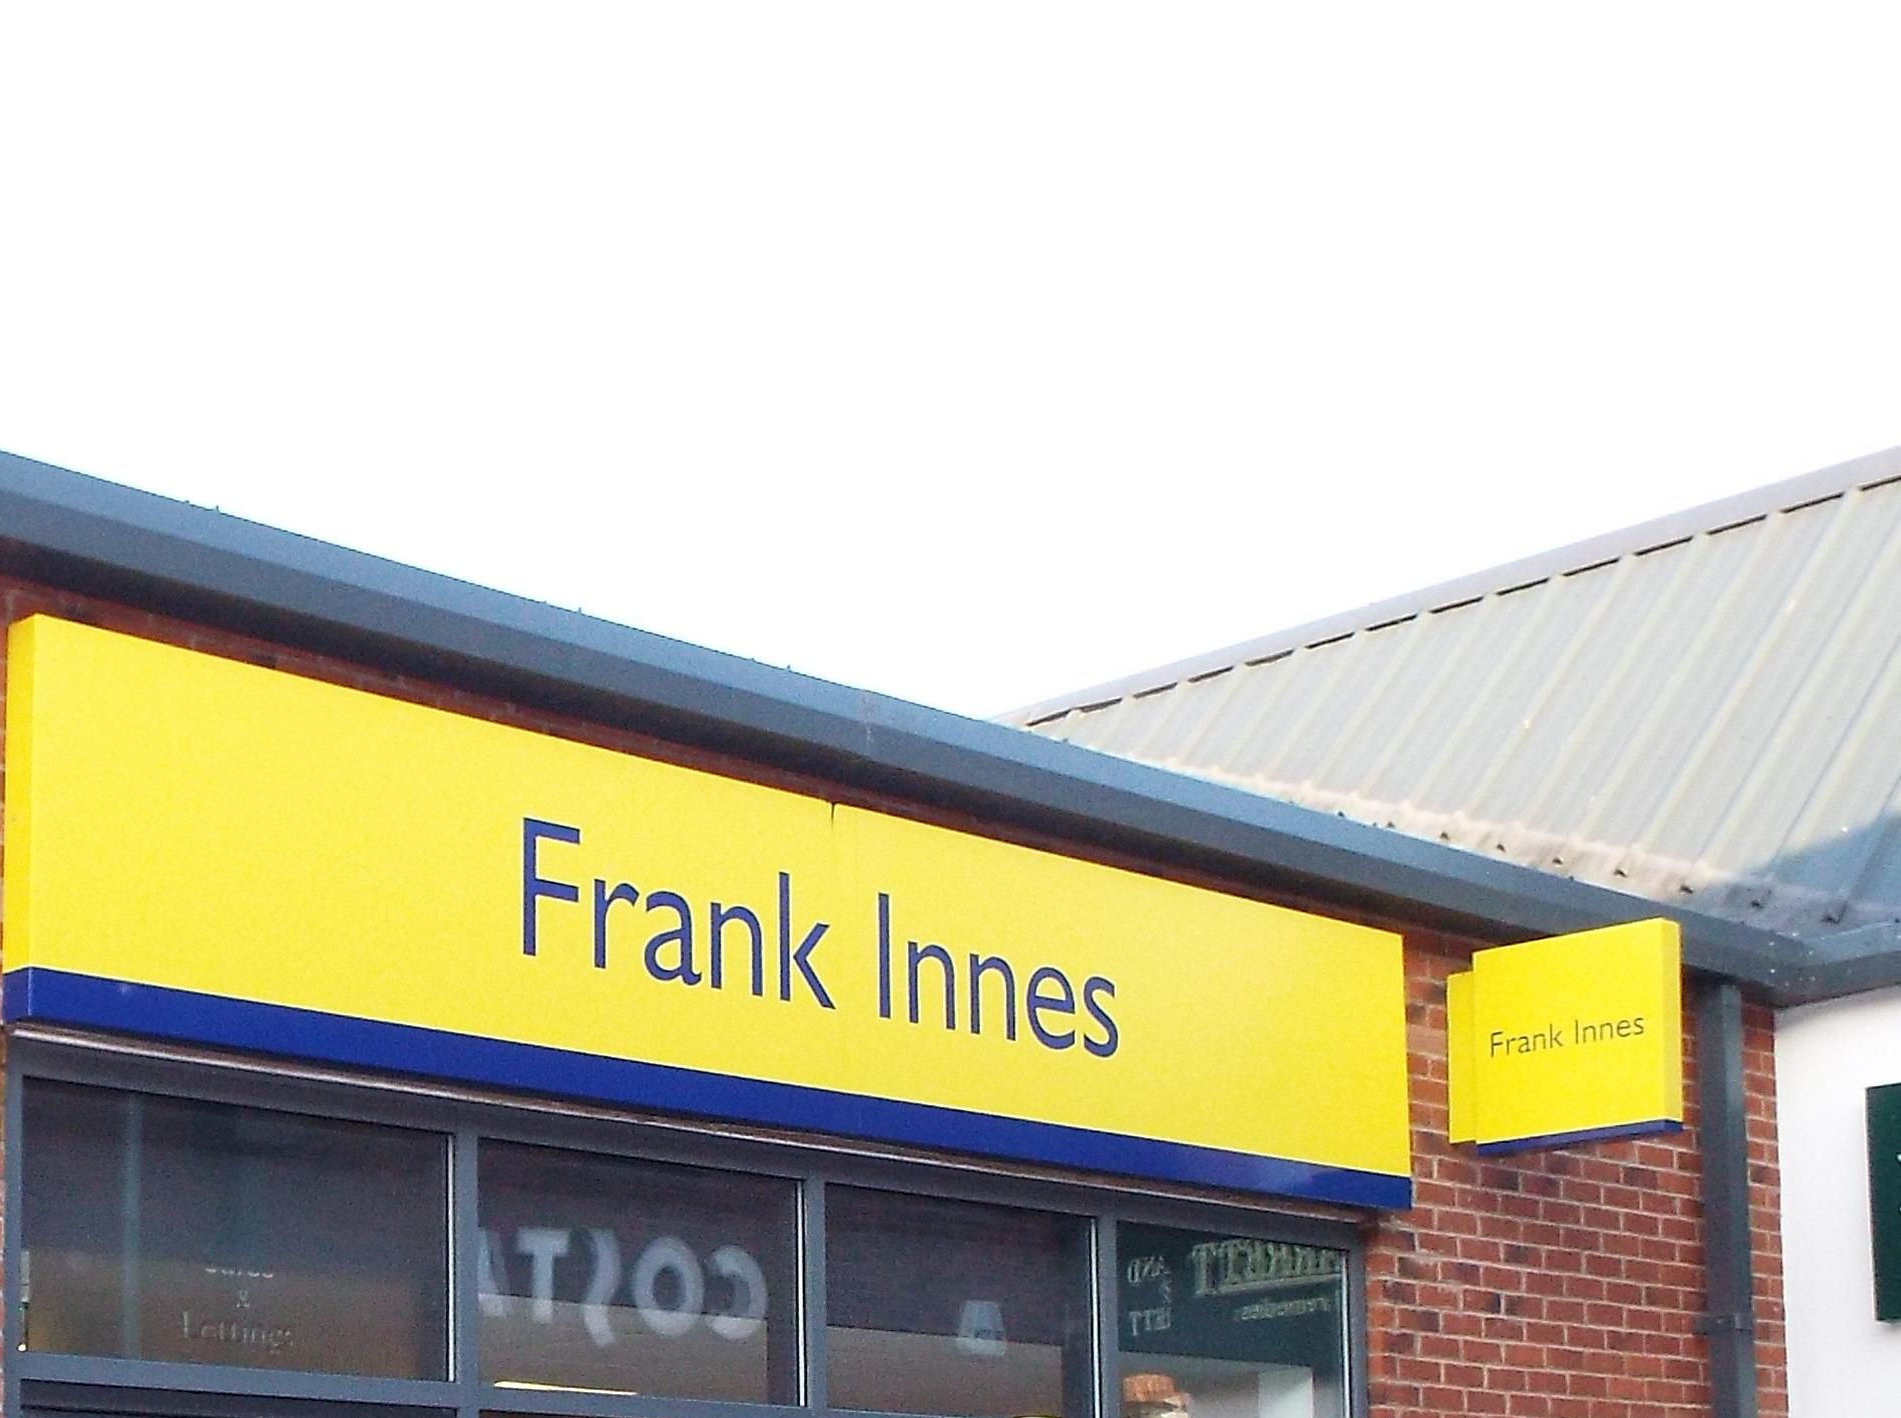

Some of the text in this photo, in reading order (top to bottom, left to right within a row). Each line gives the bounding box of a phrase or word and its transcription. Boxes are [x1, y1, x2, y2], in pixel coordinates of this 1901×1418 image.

[523, 816, 1119, 1059] Frank Innes
[1489, 1015, 1646, 1058] Frank Innes
